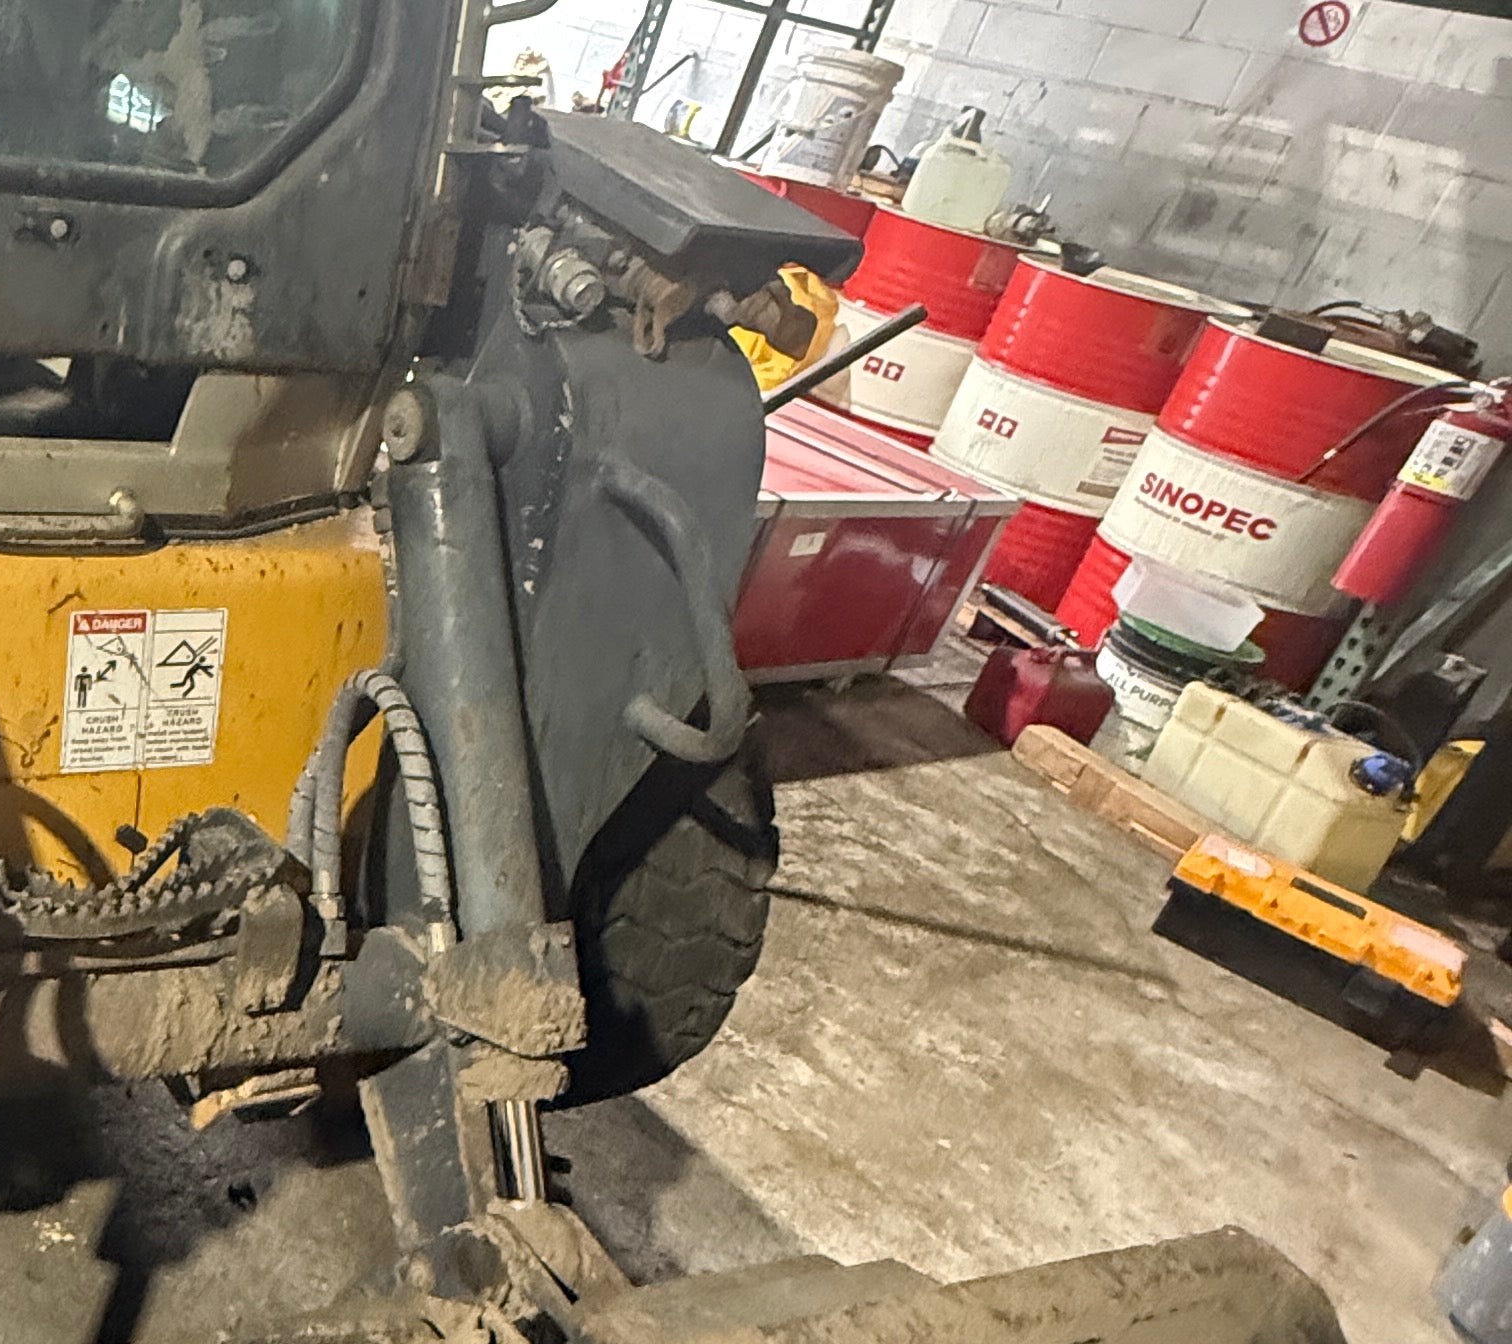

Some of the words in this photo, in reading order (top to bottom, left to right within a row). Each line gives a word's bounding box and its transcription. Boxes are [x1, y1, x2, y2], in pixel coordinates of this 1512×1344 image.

[1139, 472, 1278, 541] SINOPEC
[92, 617, 144, 631] DANGER
[1105, 673, 1127, 692] ALL
[166, 709, 199, 717] CRUSH
[86, 715, 120, 724] CRUSH
[162, 717, 203, 726] HAZARD
[81, 724, 124, 734] HAZARD
